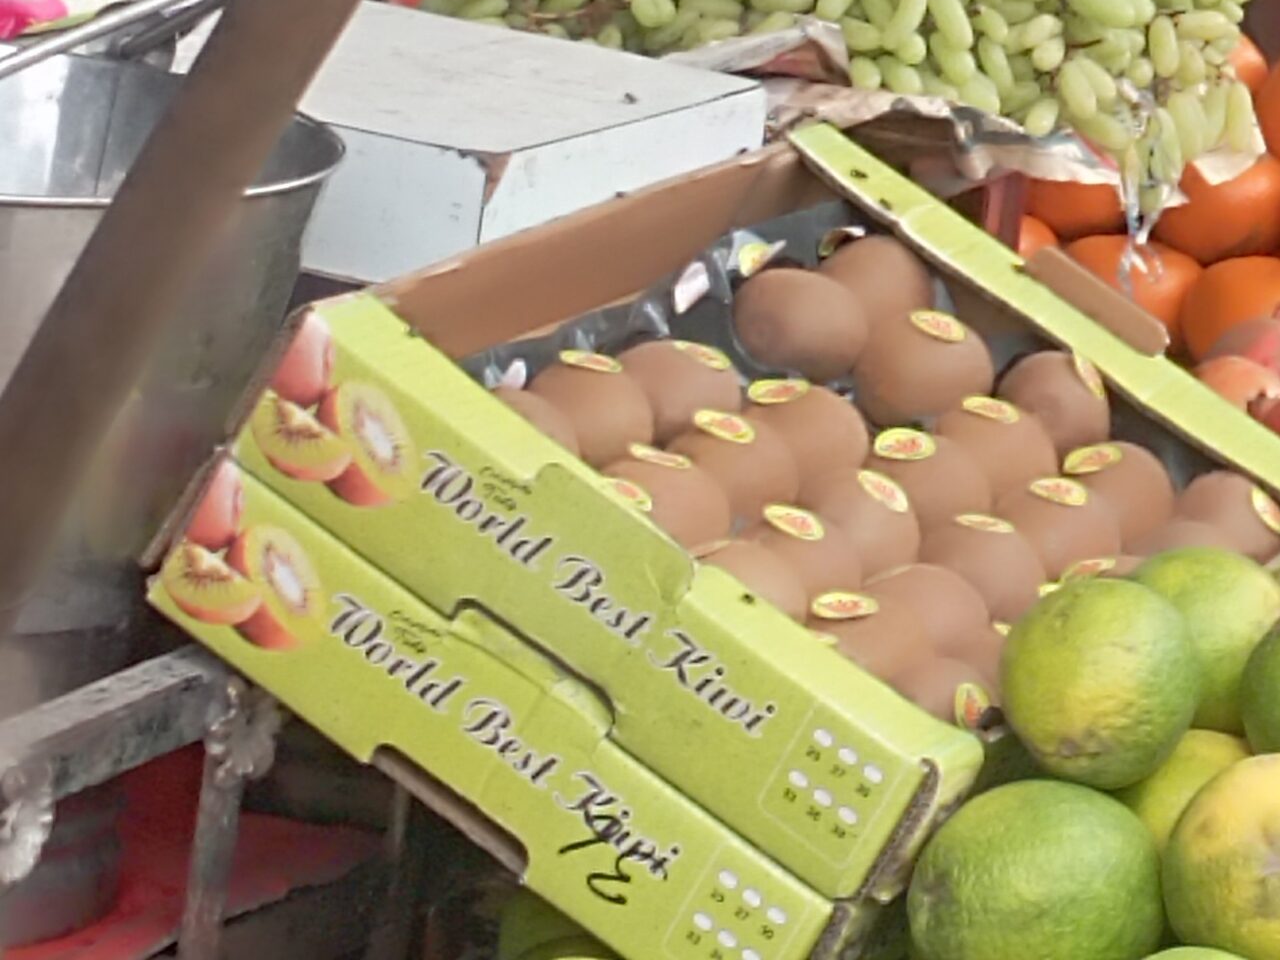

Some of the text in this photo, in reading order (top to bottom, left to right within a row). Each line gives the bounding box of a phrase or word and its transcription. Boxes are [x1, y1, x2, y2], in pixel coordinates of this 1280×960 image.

[421, 451, 554, 565] World
[554, 555, 652, 640] Best
[650, 628, 777, 732] Kiwi
[330, 593, 463, 709] World
[463, 698, 559, 782] Best
[555, 772, 680, 873] Kiwi
